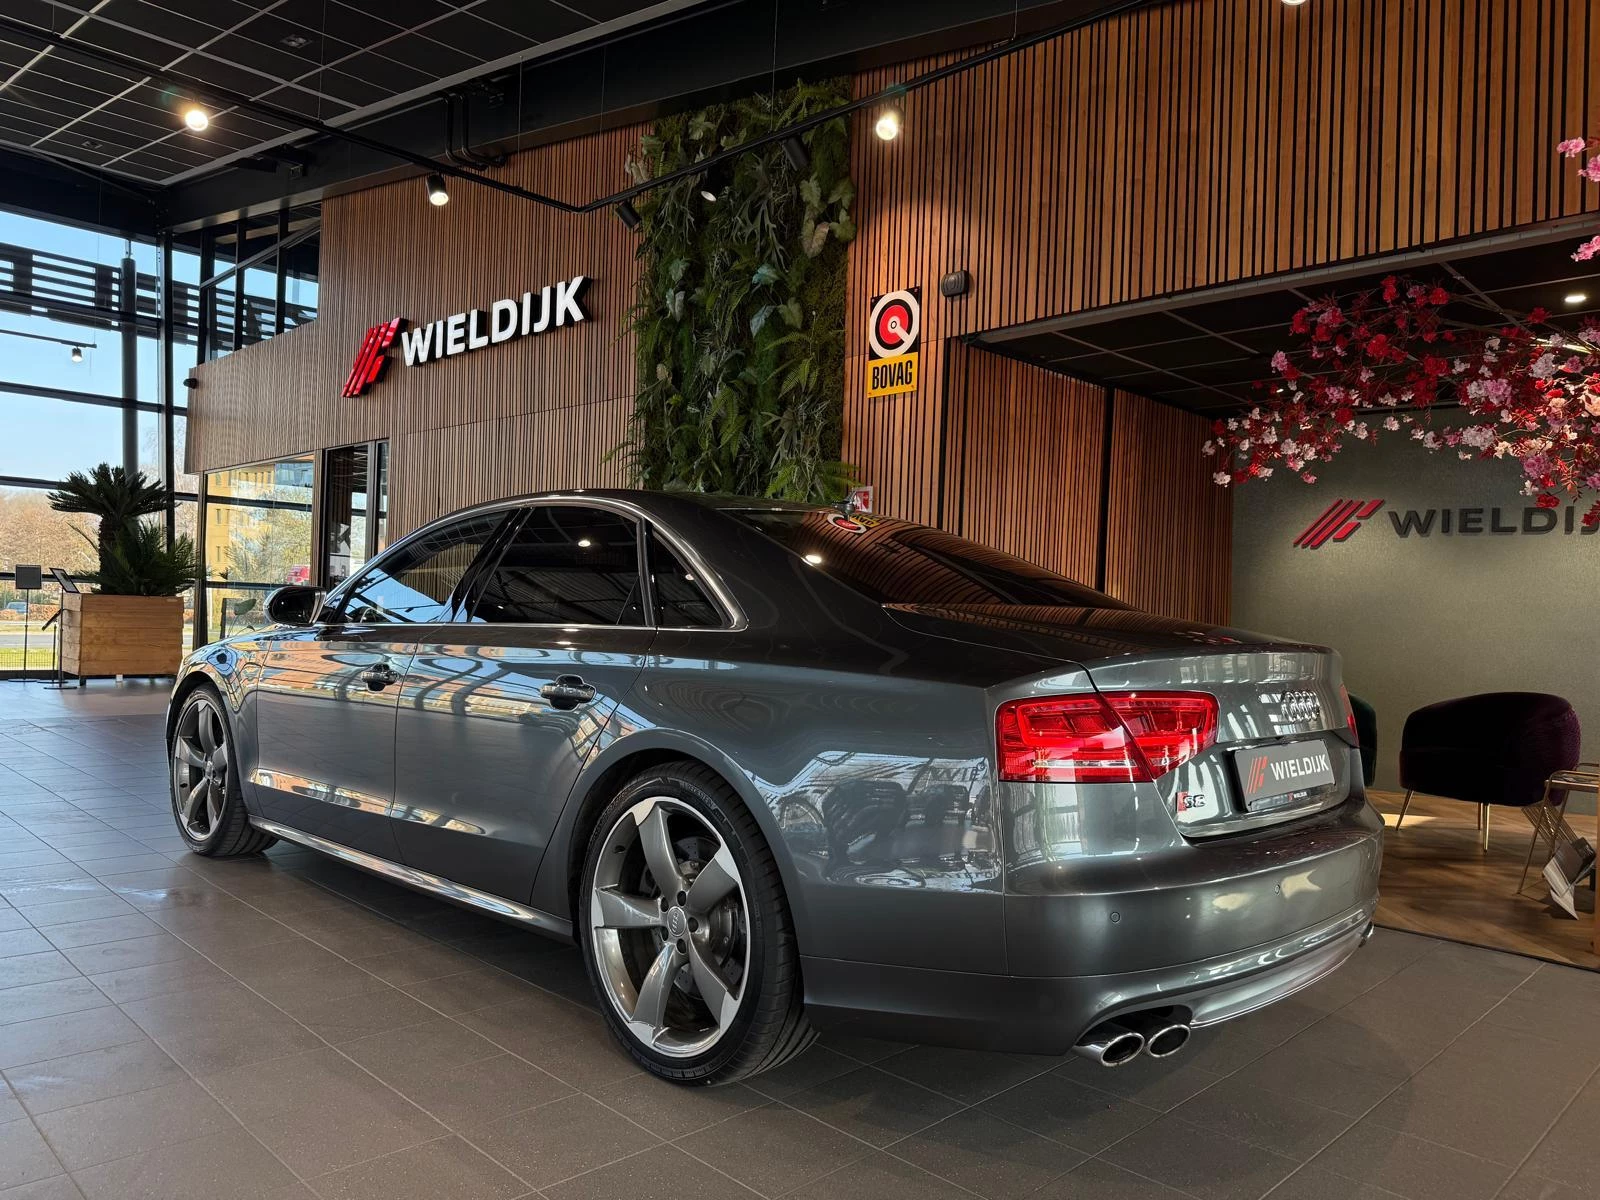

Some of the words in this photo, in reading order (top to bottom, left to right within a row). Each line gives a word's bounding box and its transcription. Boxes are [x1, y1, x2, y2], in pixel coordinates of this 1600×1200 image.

[401, 275, 585, 367] WIELDIJK
[872, 360, 913, 390] BOVAG
[1271, 754, 1329, 780] WIELDIJK
